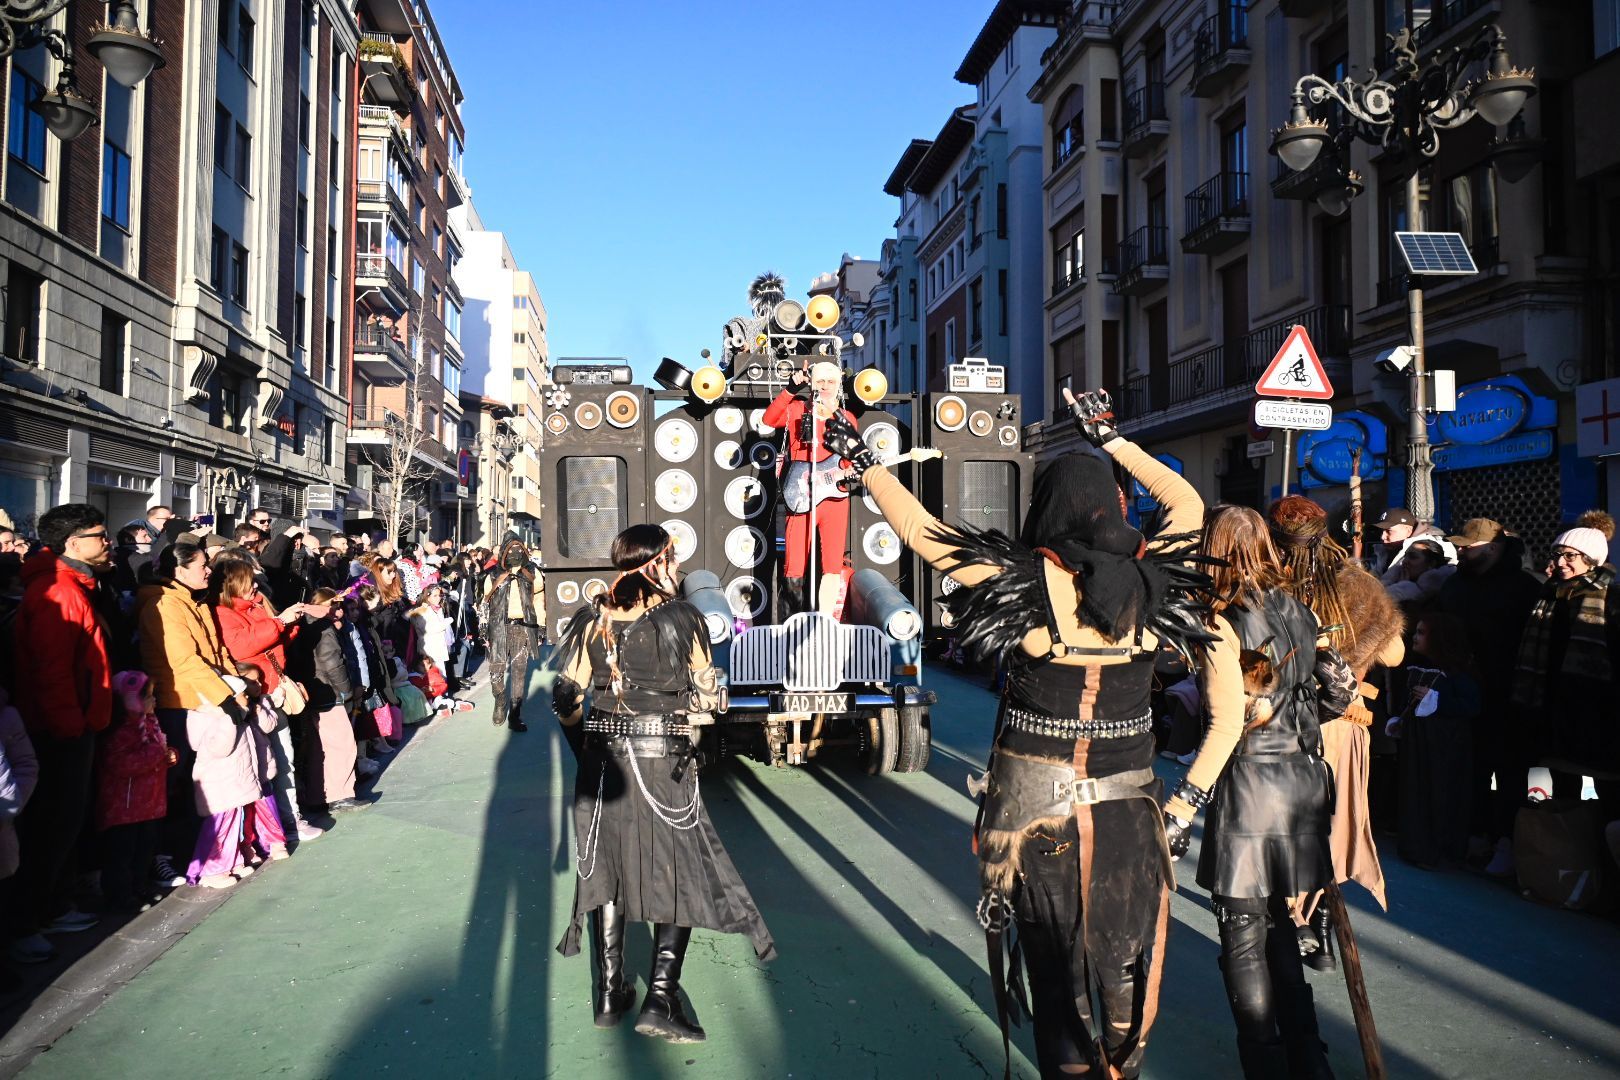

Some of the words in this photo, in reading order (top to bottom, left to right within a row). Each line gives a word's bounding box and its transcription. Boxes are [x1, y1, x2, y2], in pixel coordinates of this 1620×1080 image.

[1259, 414, 1326, 425] CONTRASENTIDO
[1447, 406, 1514, 429] Navarro
[1319, 456, 1369, 469] Navaro
[777, 695, 810, 712] MAD
[814, 694, 848, 712] MAX
